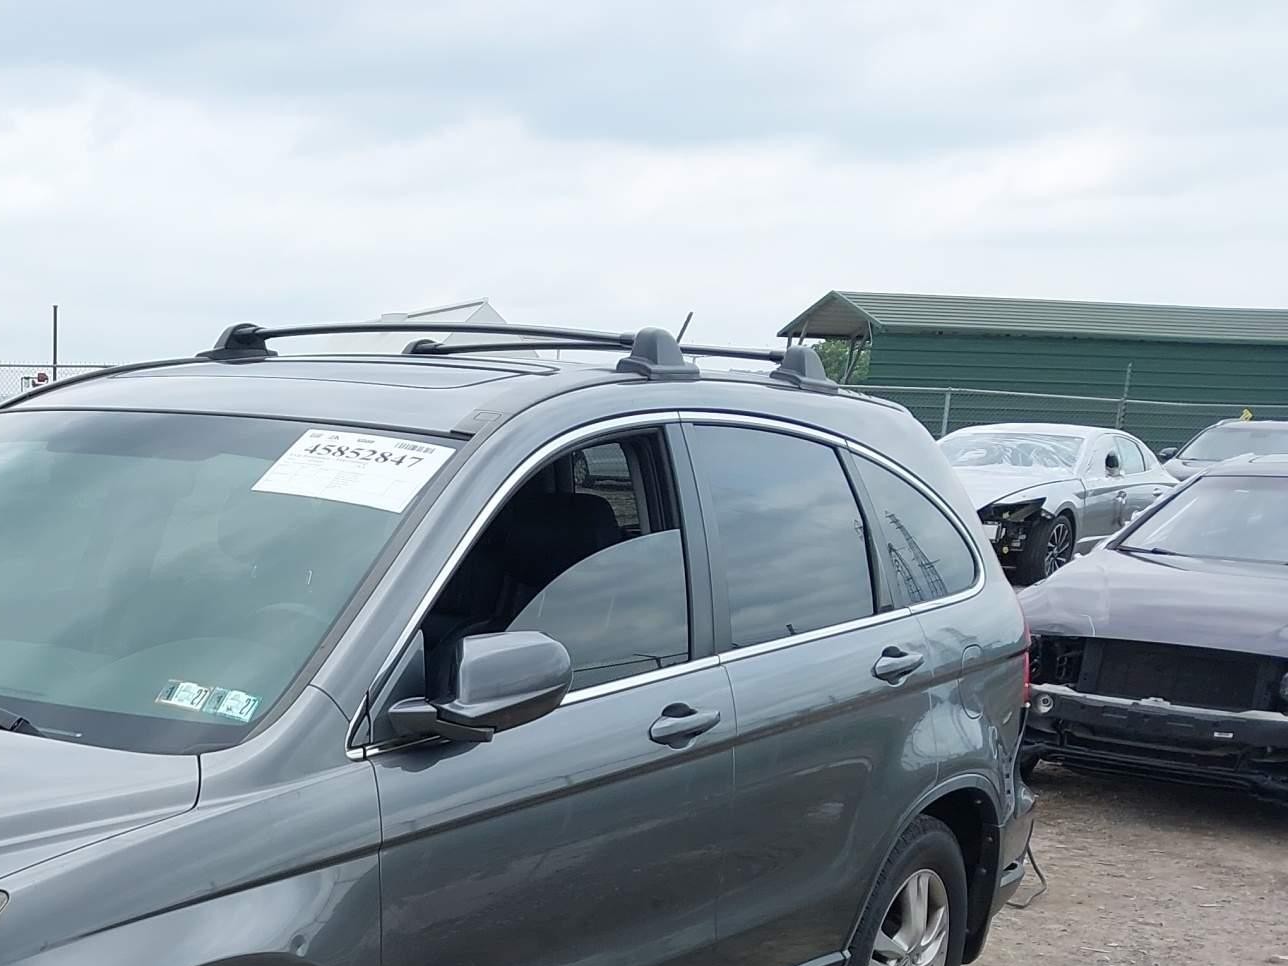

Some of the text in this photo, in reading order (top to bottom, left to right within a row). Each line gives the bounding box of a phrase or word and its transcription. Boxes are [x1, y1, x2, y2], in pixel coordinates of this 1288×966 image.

[304, 443, 424, 468] 45852847
[190, 688, 208, 707] 27
[239, 697, 257, 717] 27
